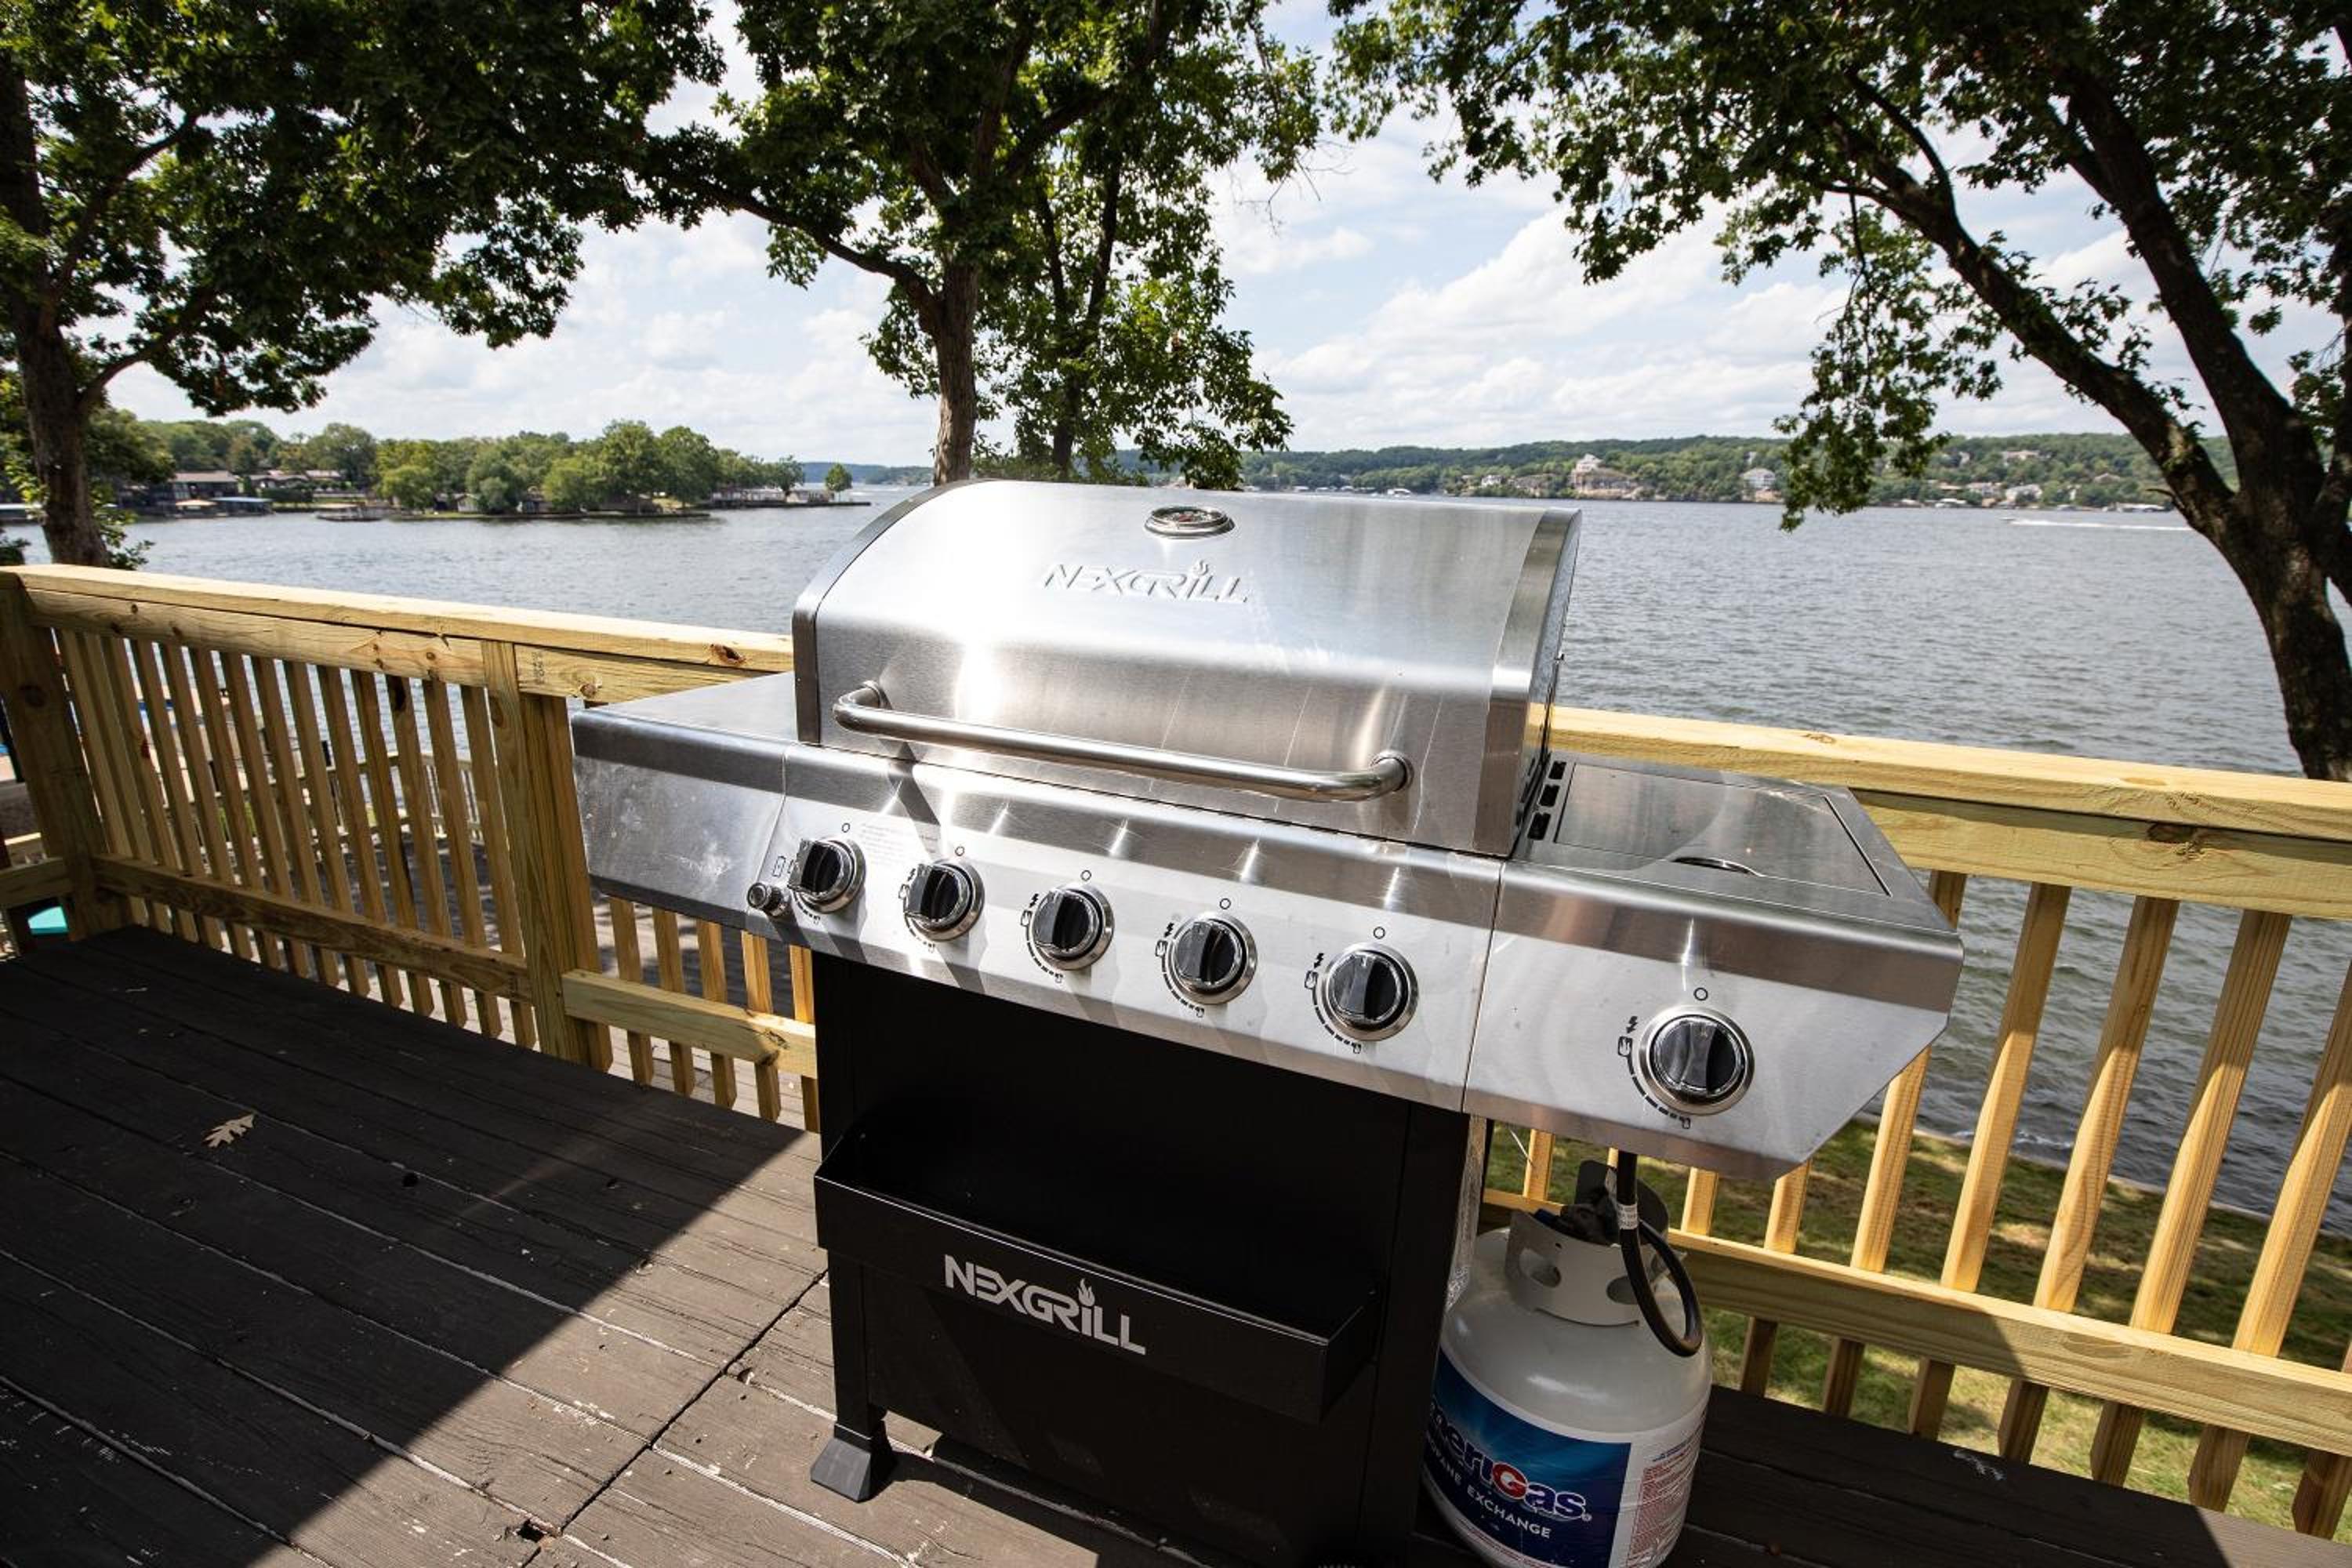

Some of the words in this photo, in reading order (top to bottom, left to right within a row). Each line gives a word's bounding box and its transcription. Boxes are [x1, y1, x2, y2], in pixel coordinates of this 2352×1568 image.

[1043, 560, 1249, 604] NEXGRILL
[944, 1254, 1146, 1356] NEXGRILL
[1466, 1485, 1552, 1540] EXCHANGE
